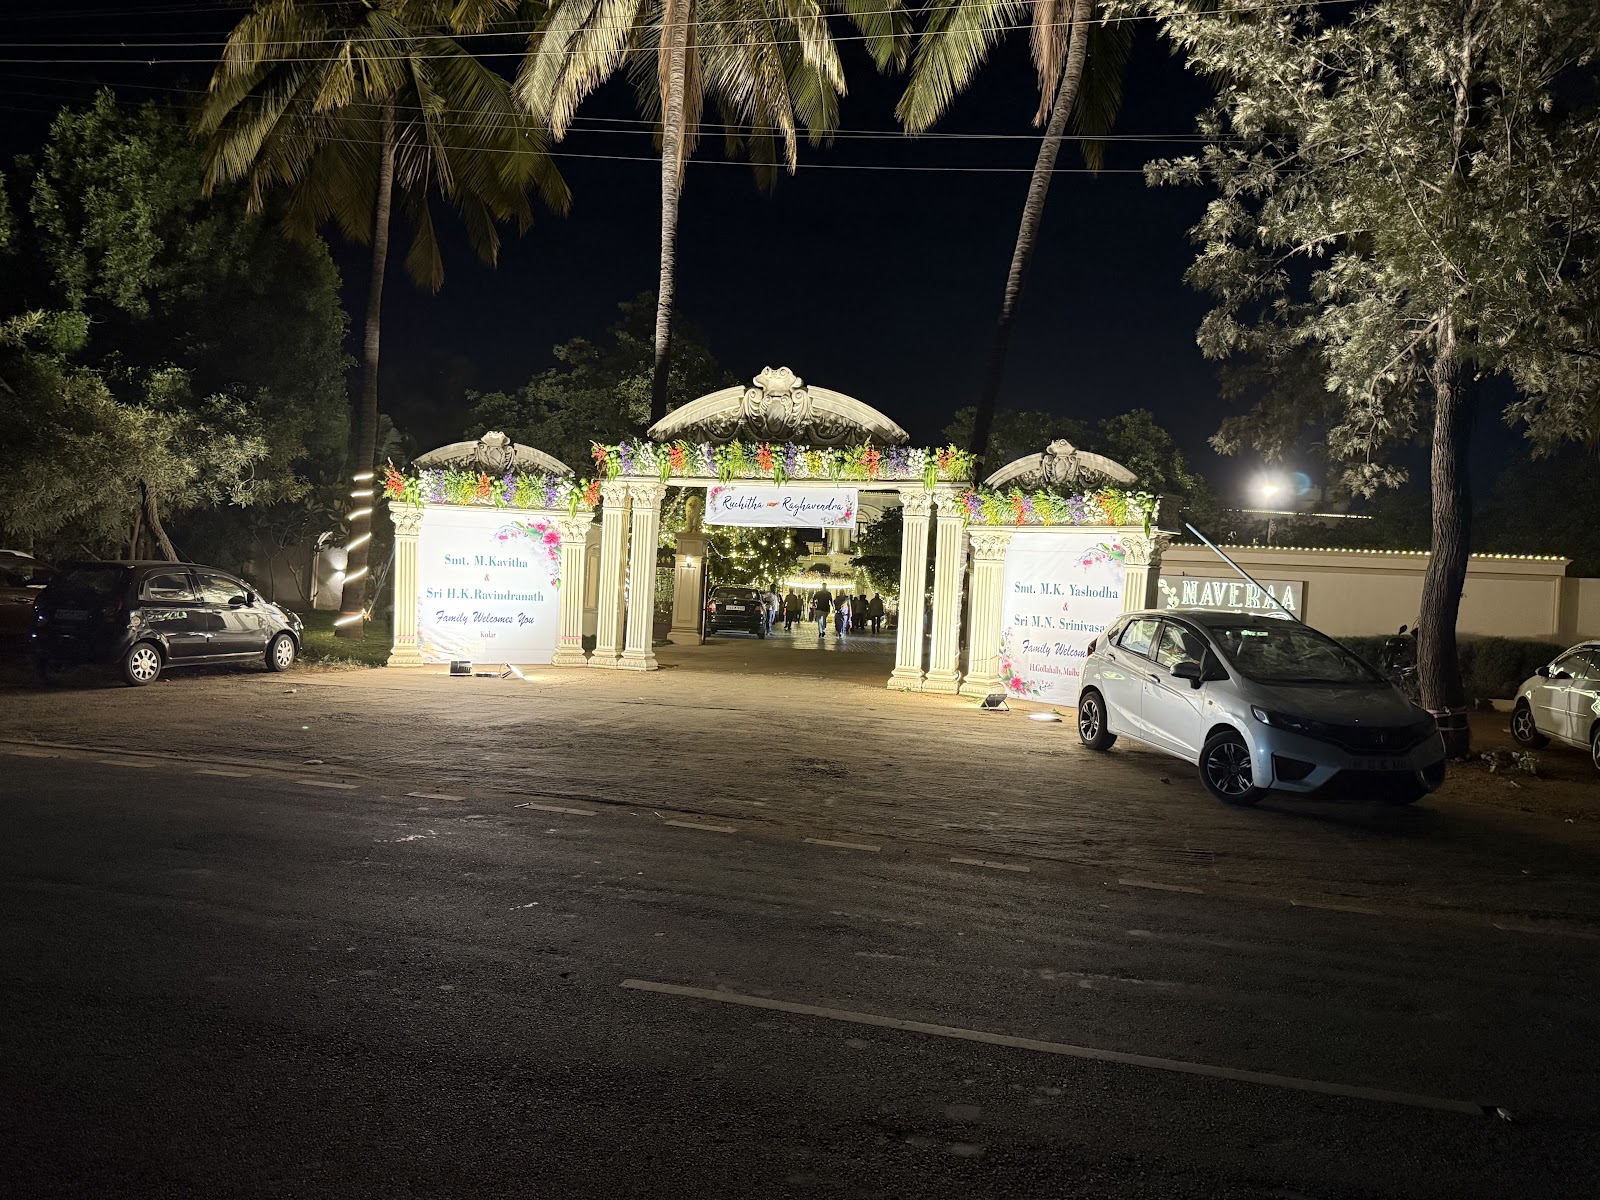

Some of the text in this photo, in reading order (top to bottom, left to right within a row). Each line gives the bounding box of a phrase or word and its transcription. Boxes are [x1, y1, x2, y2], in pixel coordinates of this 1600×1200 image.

[722, 496, 844, 517] Ruchitha Raghavendra
[444, 554, 528, 568] Smt. M.Kavitha
[484, 573, 490, 582] &
[426, 587, 442, 598] Sri
[1014, 581, 1118, 599] Smt. M.K. Yashodha
[1181, 580, 1296, 610] NAVERAA
[1062, 602, 1069, 612] &
[435, 610, 535, 627] Family Welcomes You
[1014, 614, 1108, 633] Sri M.N. Srinivasa
[1022, 639, 1087, 658] Family Welcom
